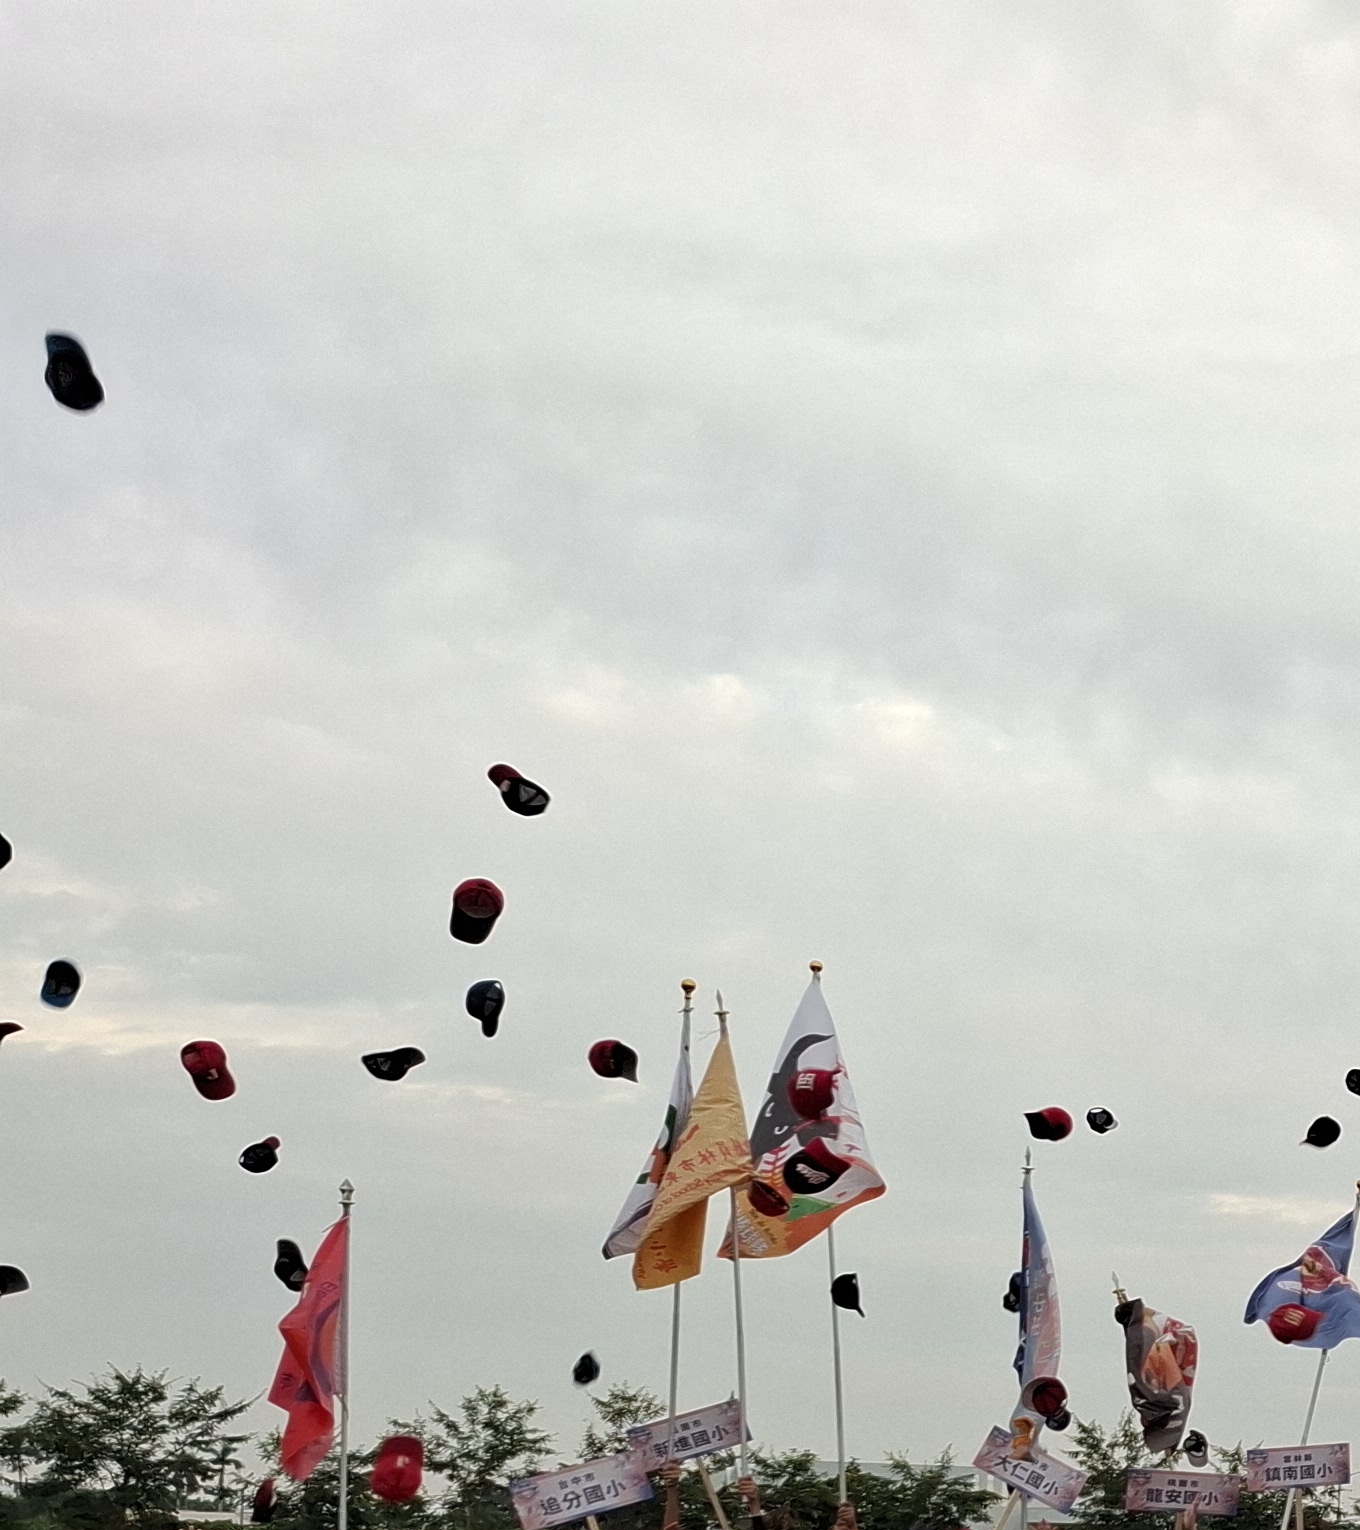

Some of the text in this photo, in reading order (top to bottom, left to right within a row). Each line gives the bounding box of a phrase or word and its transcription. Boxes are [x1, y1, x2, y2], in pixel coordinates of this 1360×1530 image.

[993, 1455, 1060, 1497] 大仁國小
[1264, 1461, 1334, 1483] 鎮南國小
[538, 1478, 627, 1517] 追分國小
[1145, 1487, 1219, 1507] 龍安國小
